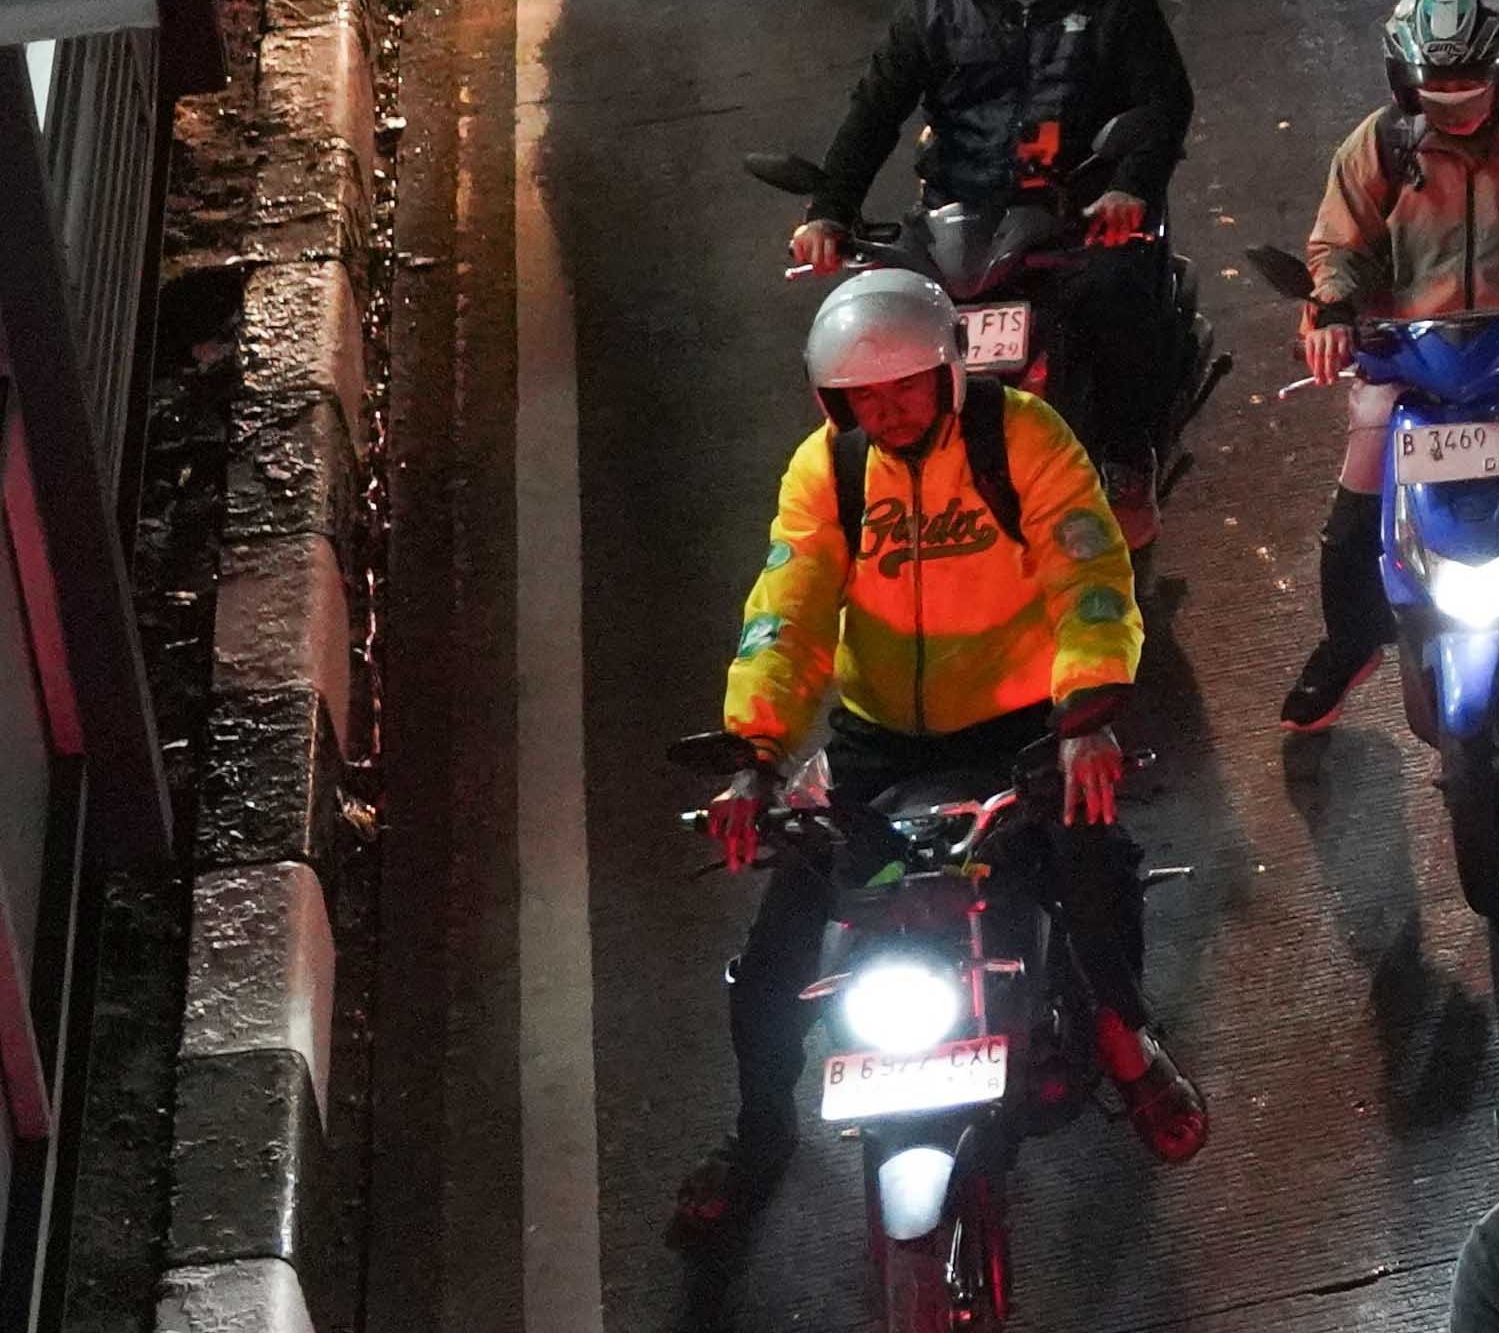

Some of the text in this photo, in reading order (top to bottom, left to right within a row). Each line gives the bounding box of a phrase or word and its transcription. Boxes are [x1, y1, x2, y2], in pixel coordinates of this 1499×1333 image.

[980, 311, 1023, 336] FTS
[1403, 433, 1416, 456] B
[831, 1062, 844, 1086] B
